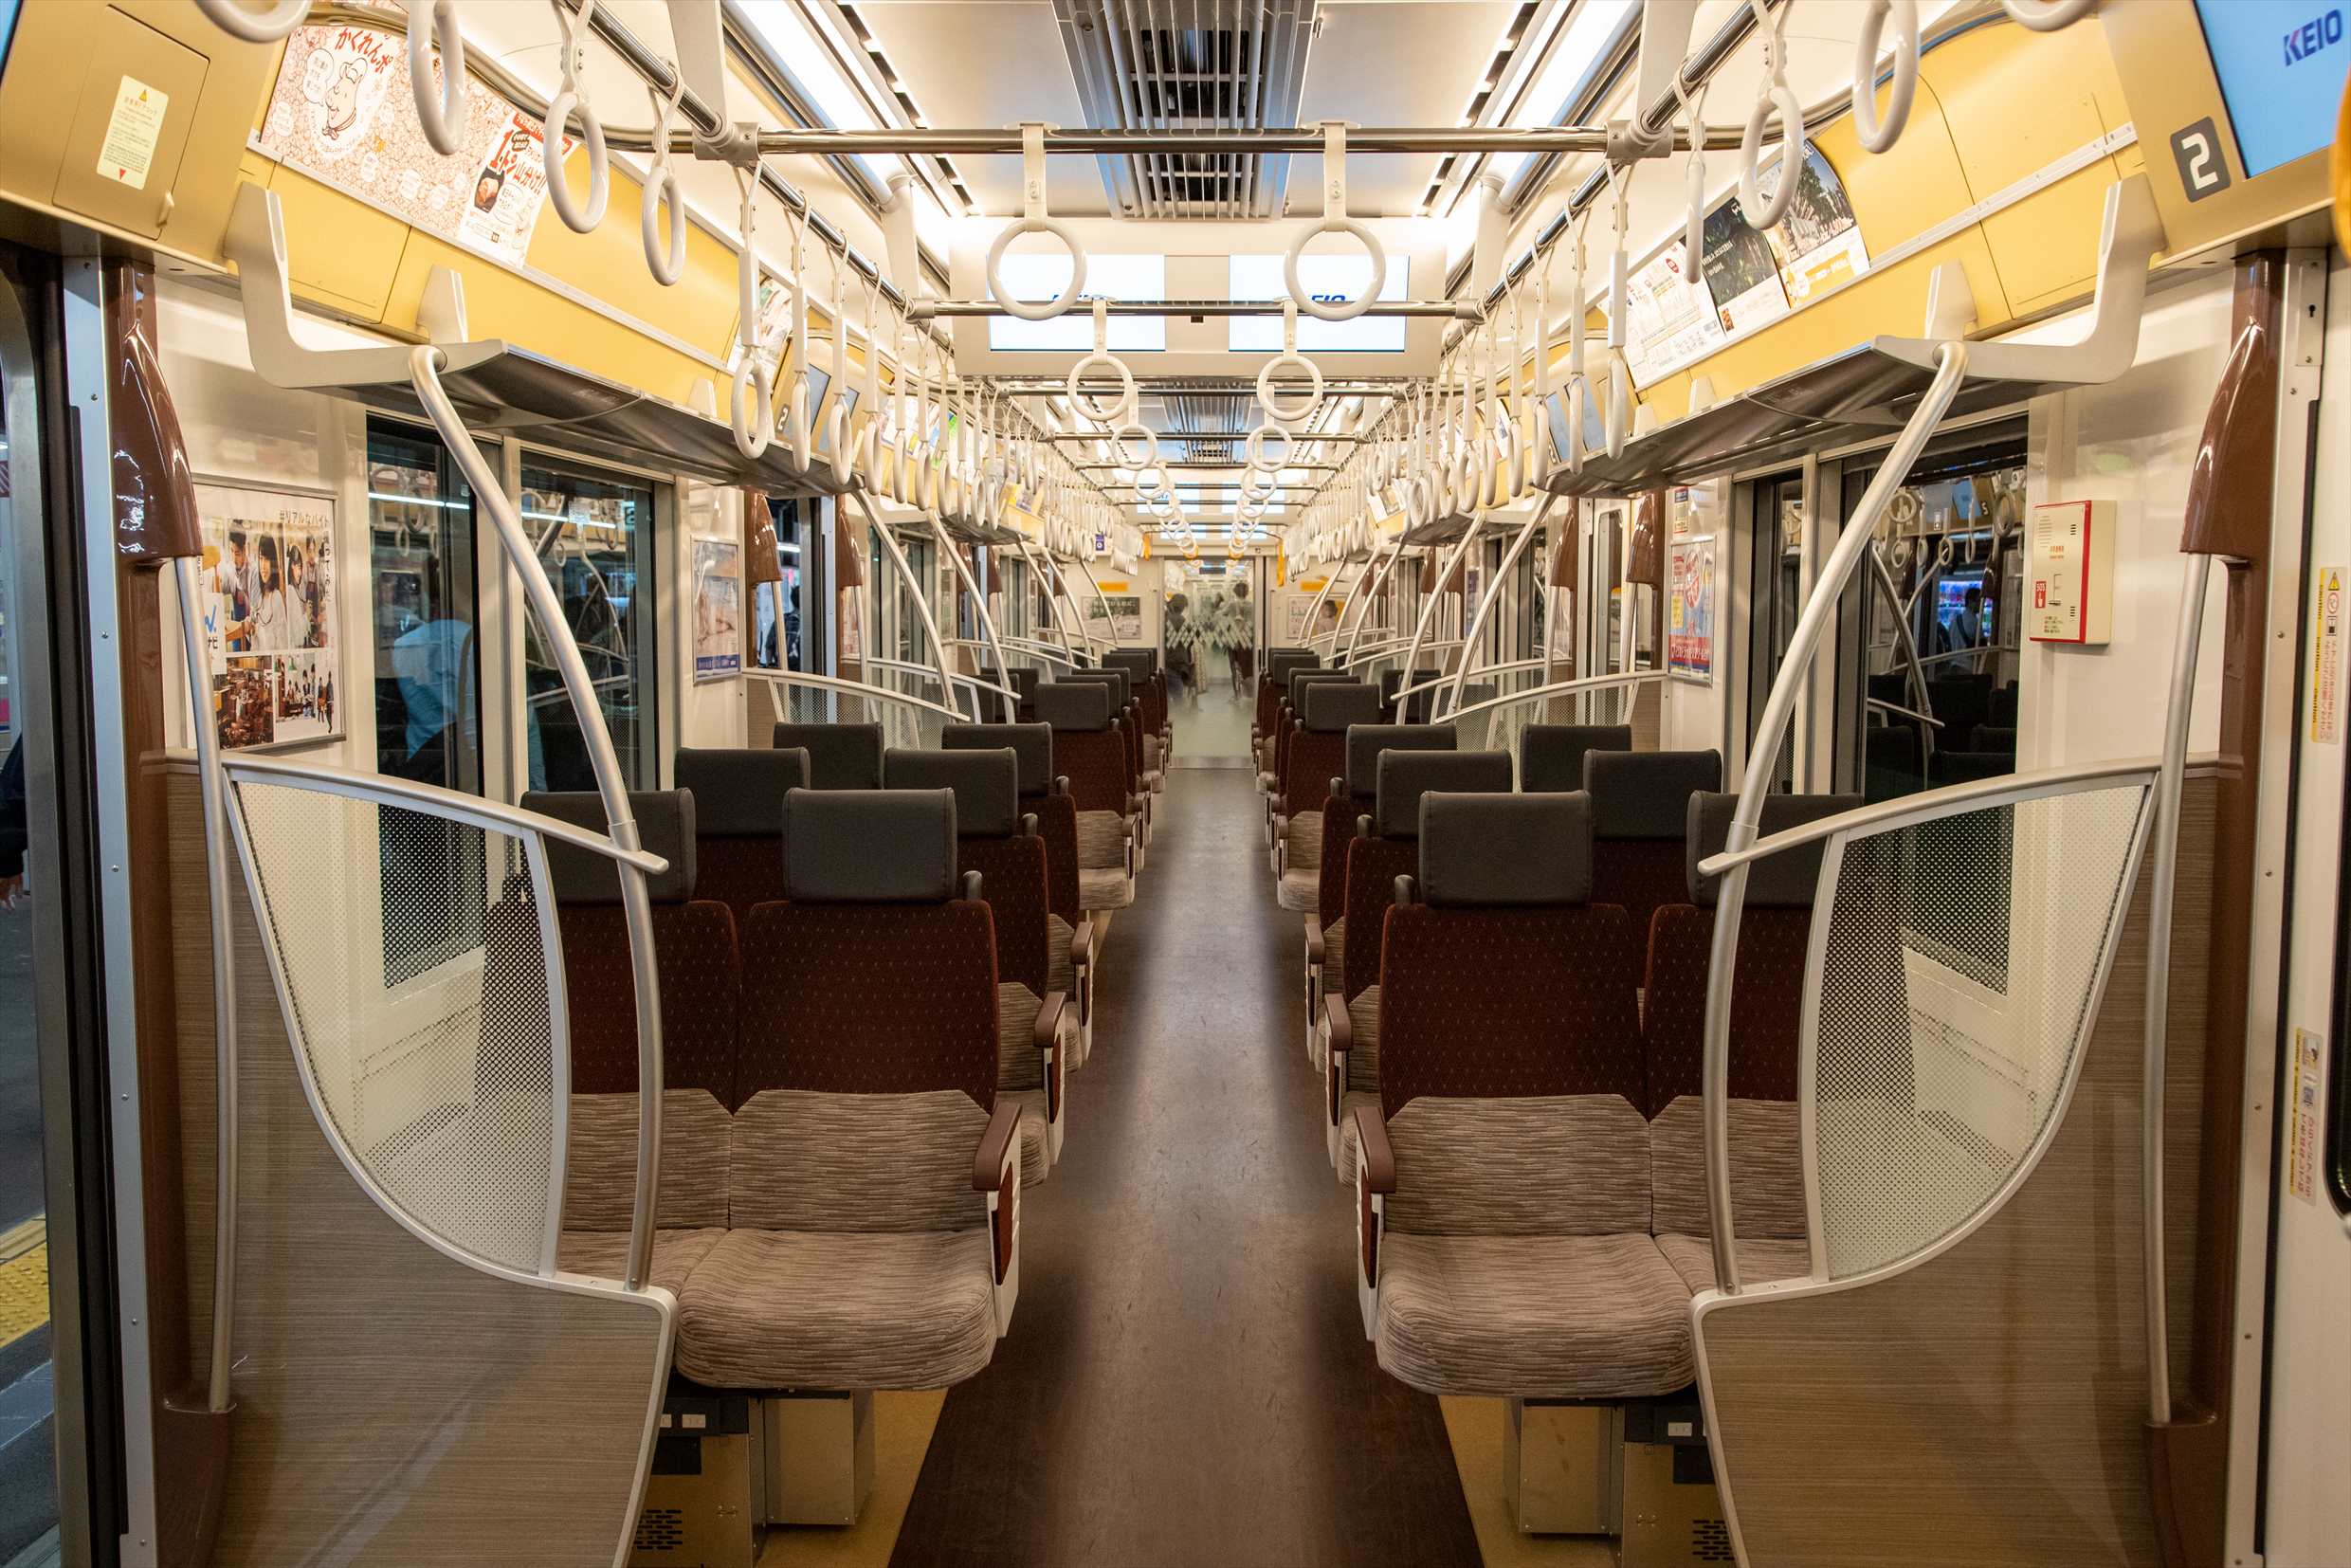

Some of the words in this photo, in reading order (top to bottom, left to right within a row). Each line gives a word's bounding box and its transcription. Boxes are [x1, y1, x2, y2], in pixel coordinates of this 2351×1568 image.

[2283, 9, 2342, 66] KEIO
[2181, 133, 2218, 191] 2
[777, 407, 789, 431] 2
